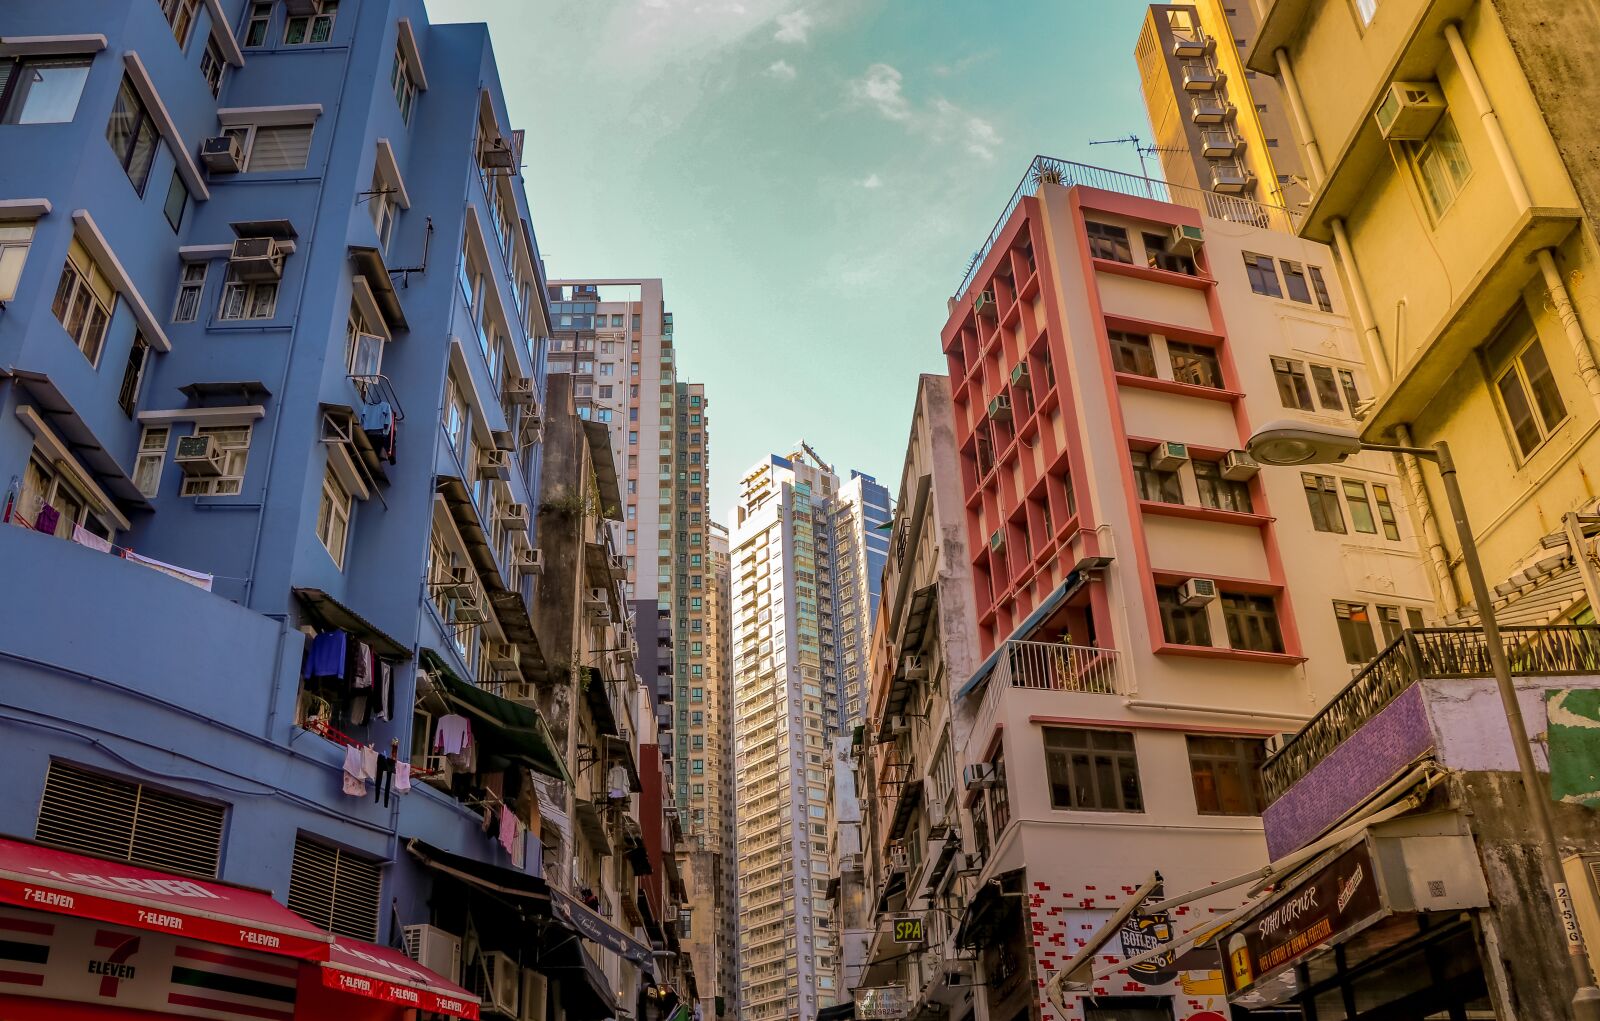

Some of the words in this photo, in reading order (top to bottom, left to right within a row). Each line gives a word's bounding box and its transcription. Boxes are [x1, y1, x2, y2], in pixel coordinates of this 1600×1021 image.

[24, 888, 74, 908] 7-ELEVEN
[138, 910, 182, 929] 7-ELEVEN
[1259, 910, 1280, 940] SOHO
[1282, 886, 1318, 925] CORNER
[1557, 888, 1578, 941] 21536
[239, 930, 280, 948] 7-ELEVEN
[896, 921, 921, 939] SPA
[1122, 930, 1158, 949] BOILER
[88, 960, 135, 979] ELEVEN
[94, 929, 142, 998] 7
[339, 974, 371, 991] 7-ELEVEN
[390, 986, 418, 1003] 7-ELEVEN
[436, 997, 463, 1012] 7-ELEVEN
